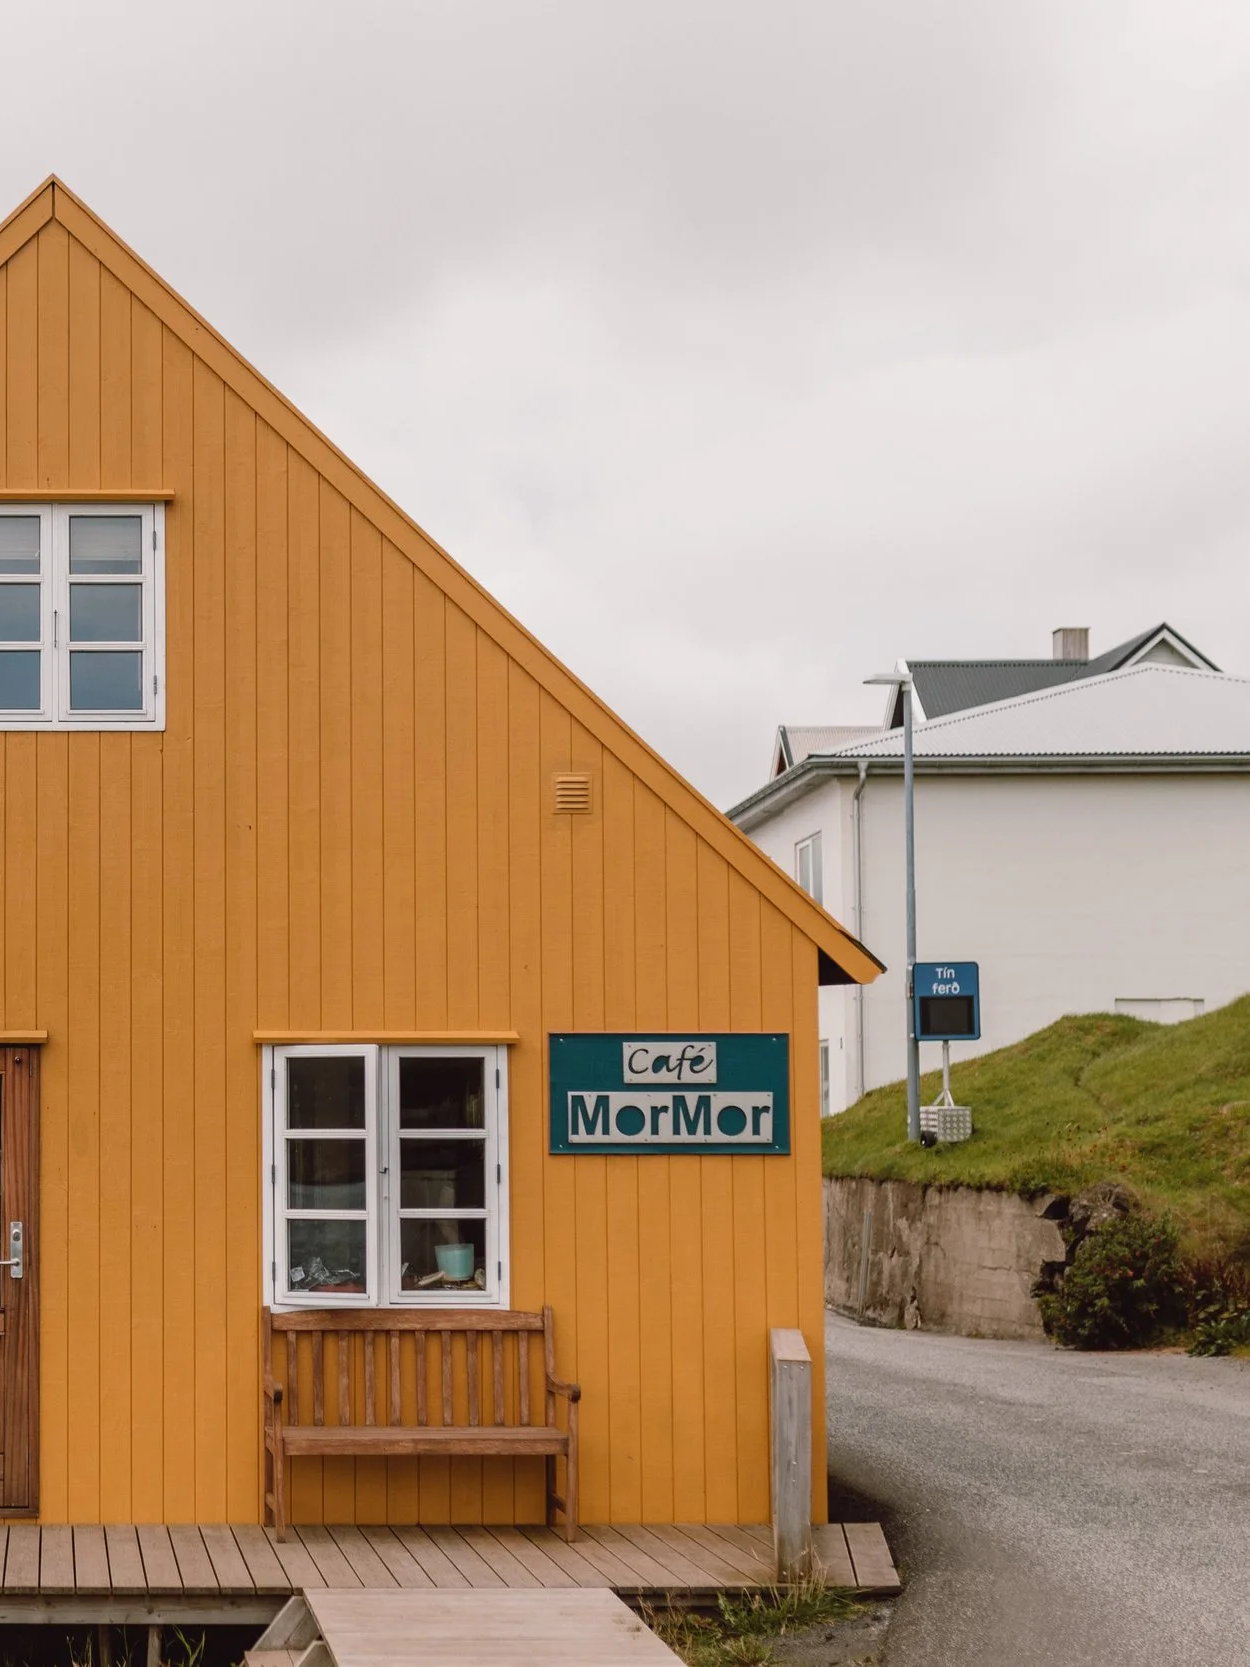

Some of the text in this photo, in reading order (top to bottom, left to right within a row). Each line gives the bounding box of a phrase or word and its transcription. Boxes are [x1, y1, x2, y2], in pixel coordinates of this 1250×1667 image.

[935, 966, 956, 979] Tín
[932, 982, 960, 995] ferð
[628, 1045, 713, 1080] Café
[570, 1095, 771, 1136] MorMor
